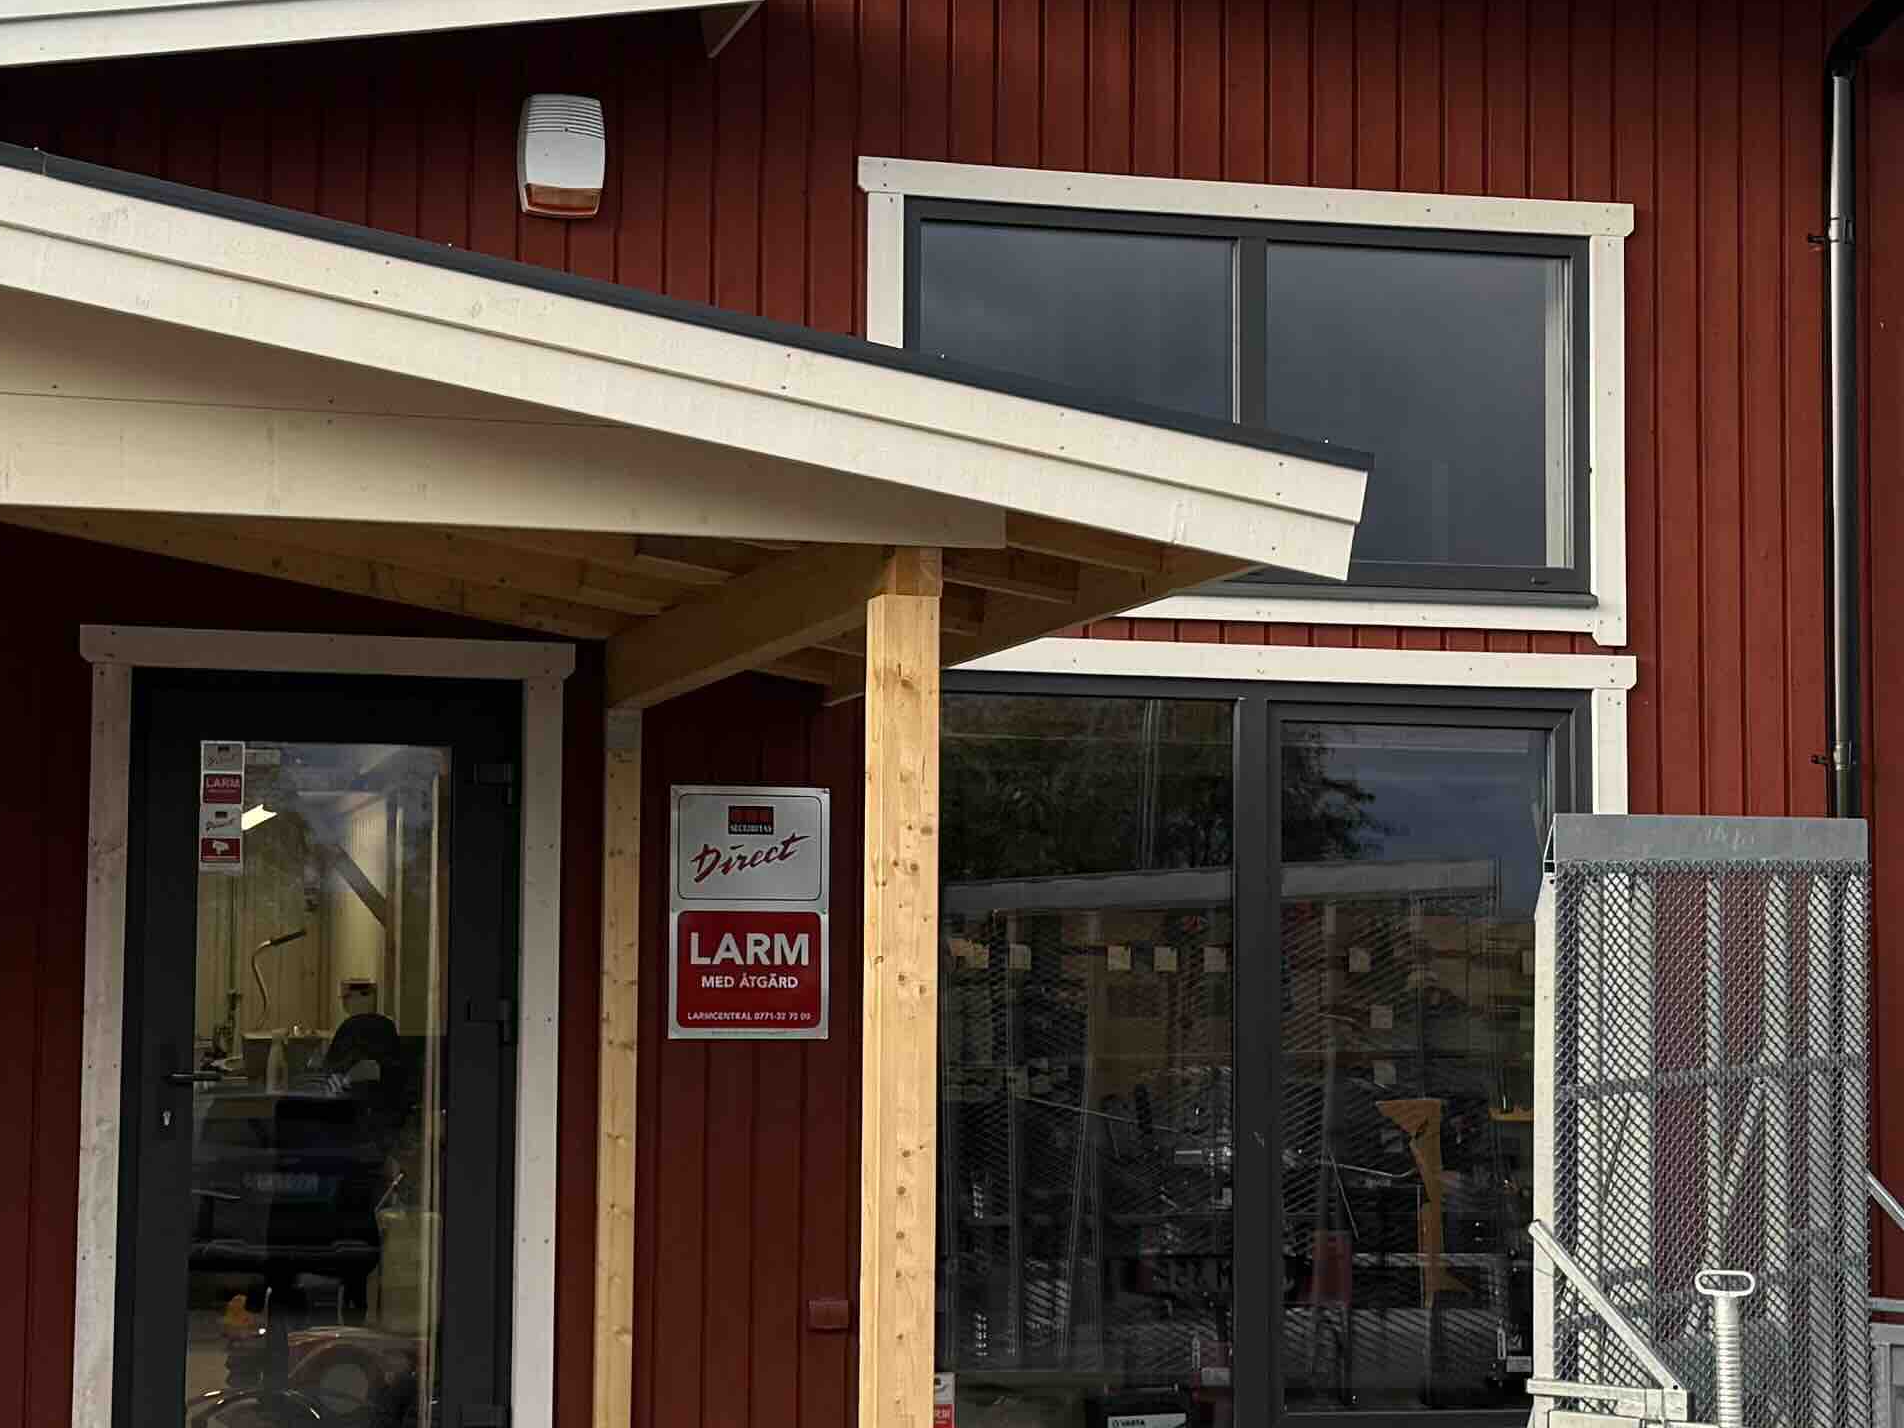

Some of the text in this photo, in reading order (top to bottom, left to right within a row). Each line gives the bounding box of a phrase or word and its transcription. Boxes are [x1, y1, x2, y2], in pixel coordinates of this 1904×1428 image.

[691, 832, 811, 883] Direct
[689, 932, 809, 966] LARM
[701, 972, 798, 989] MED ÅTGÄRD
